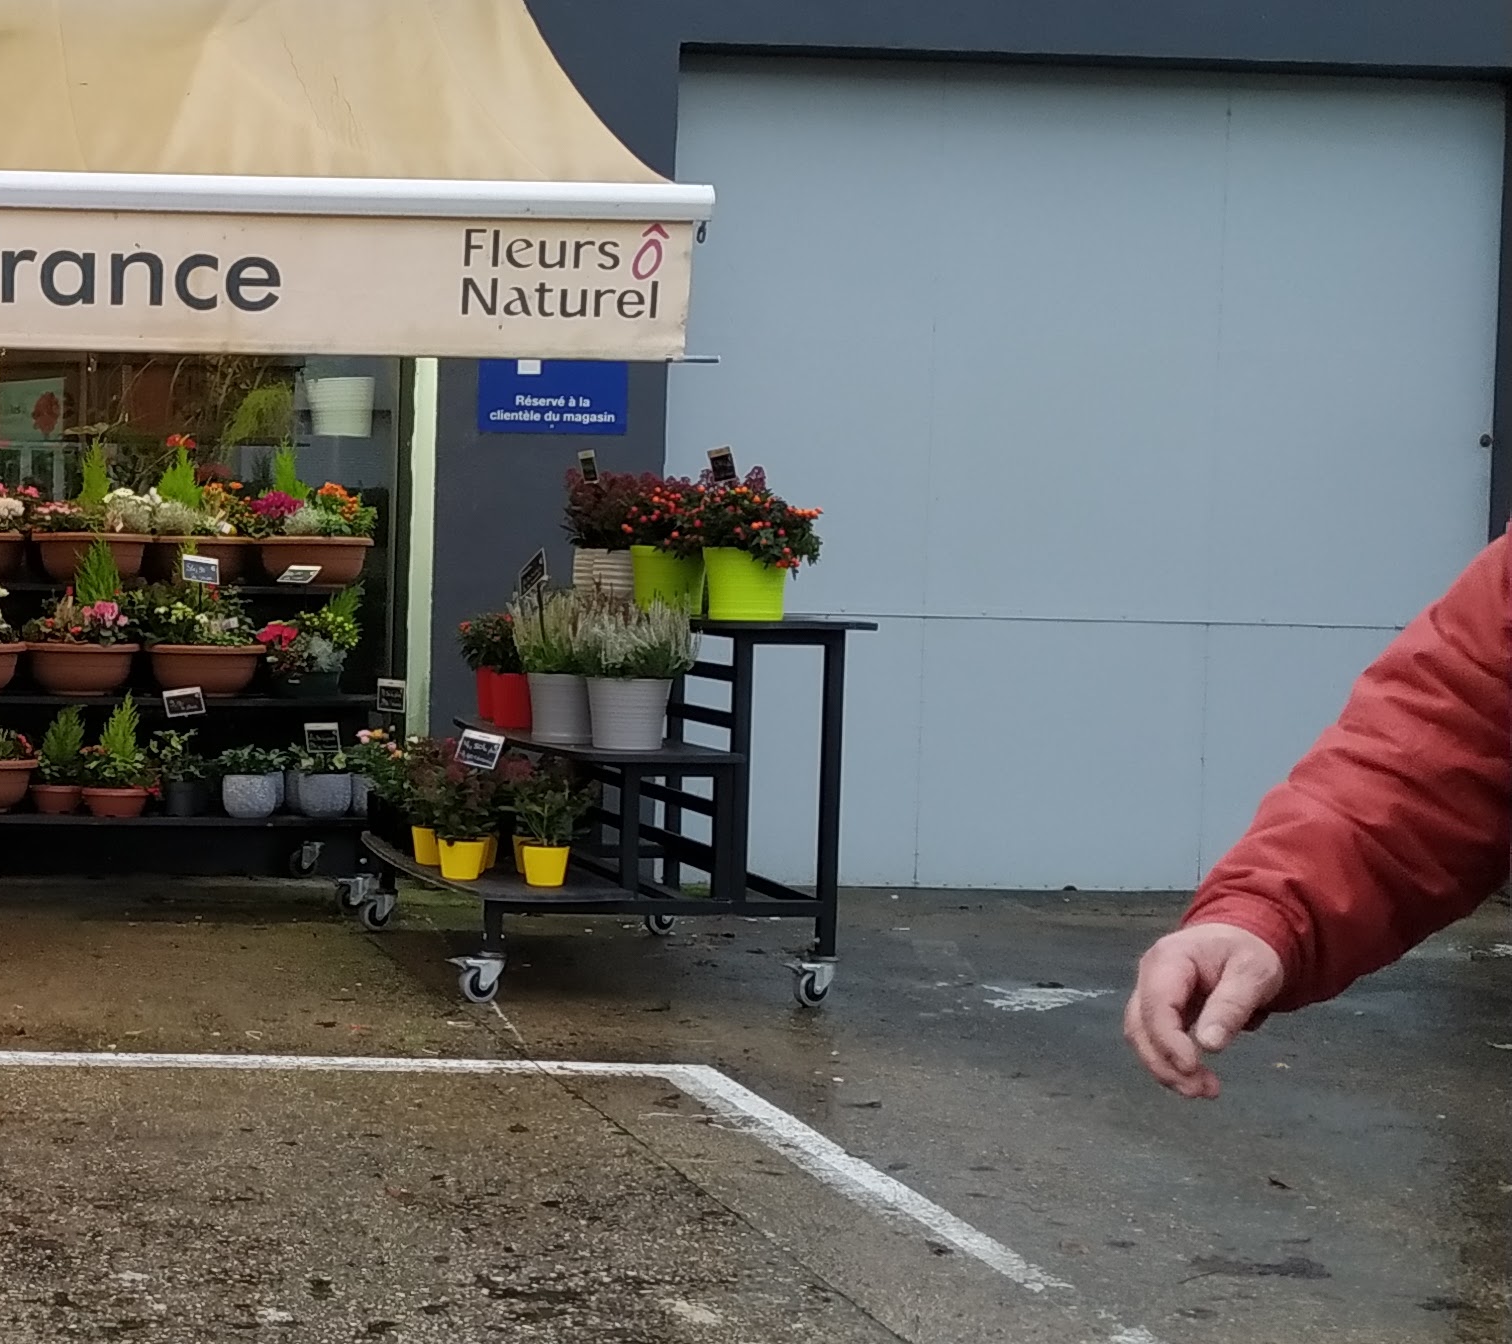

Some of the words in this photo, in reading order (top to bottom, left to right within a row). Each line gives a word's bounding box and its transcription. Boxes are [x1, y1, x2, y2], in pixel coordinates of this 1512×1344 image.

[463, 228, 621, 271] Fleurs
[631, 222, 671, 281] Ô
[460, 277, 660, 320] Naturel
[514, 394, 566, 407] Réservé
[568, 395, 577, 408] à
[578, 396, 591, 408] la
[489, 409, 542, 422] clientèle
[543, 410, 561, 422] du
[562, 411, 616, 425] magasin
